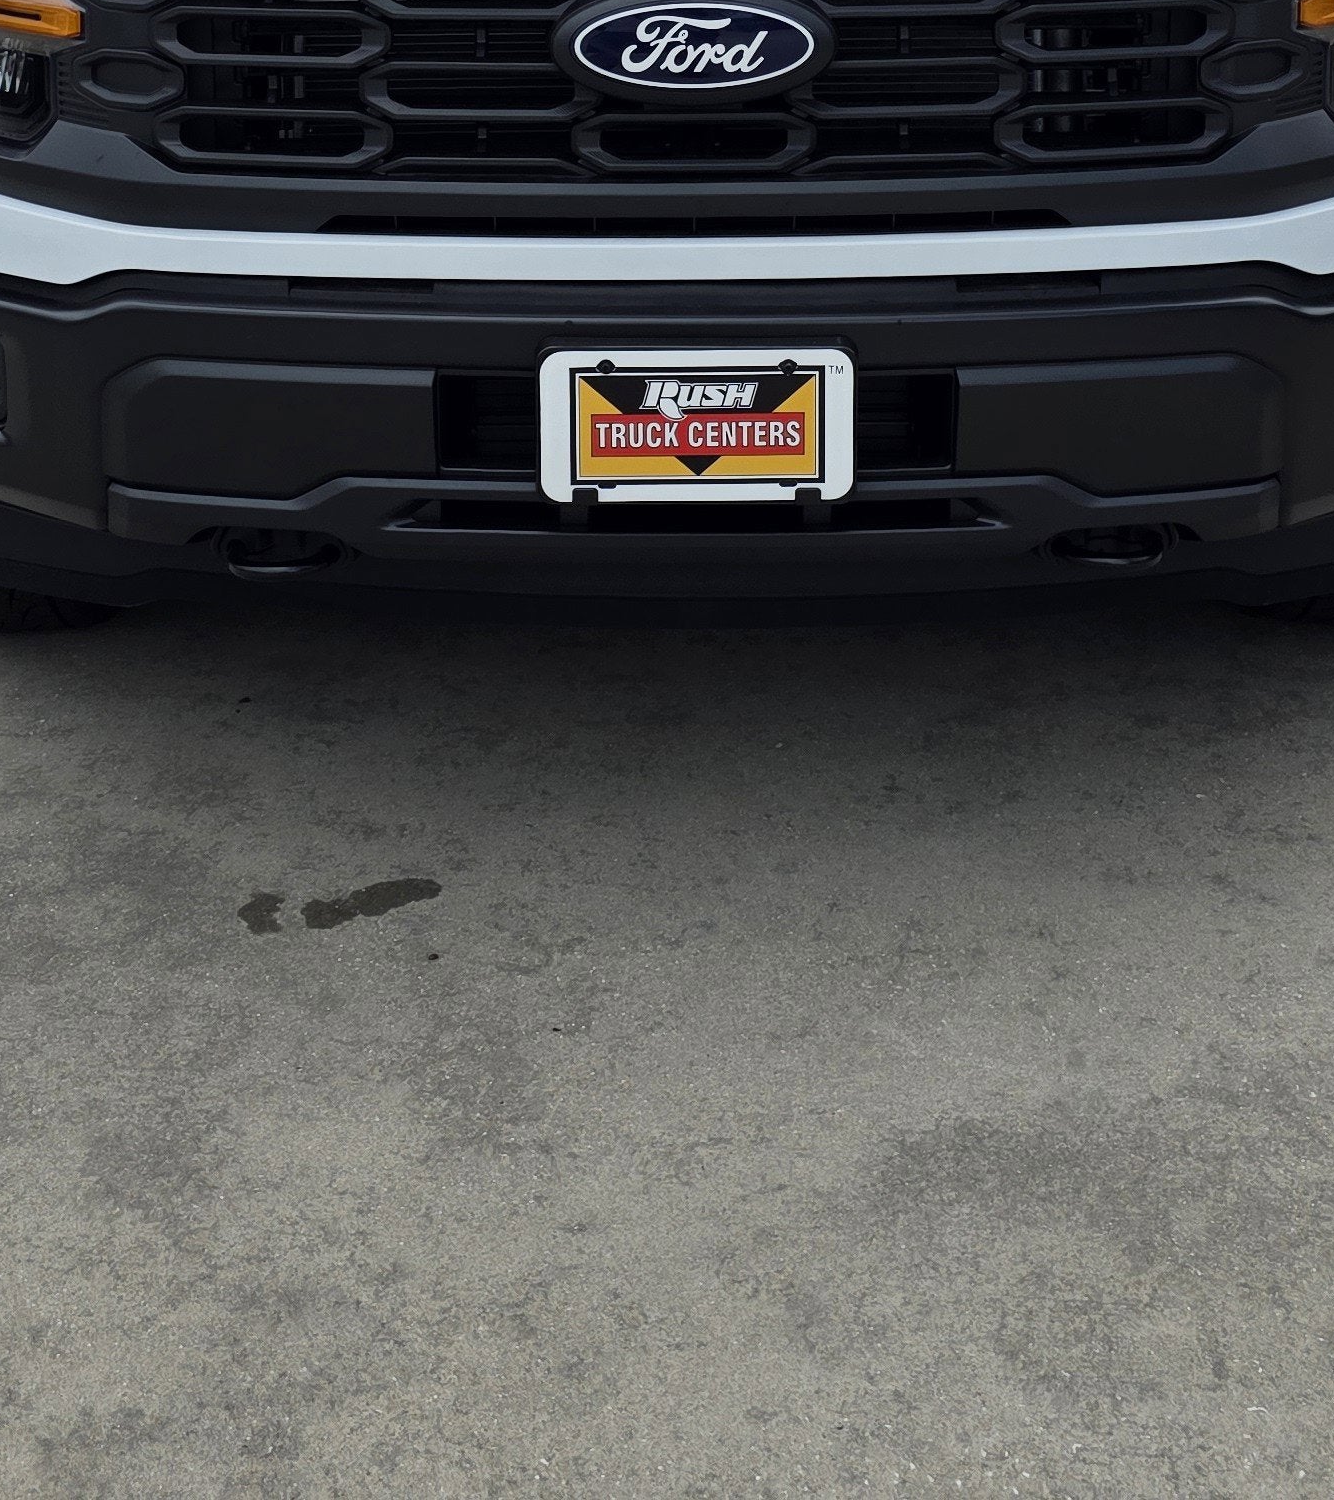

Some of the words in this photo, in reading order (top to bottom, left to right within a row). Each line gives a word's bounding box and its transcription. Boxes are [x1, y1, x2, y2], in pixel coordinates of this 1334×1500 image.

[621, 15, 769, 74] Ford
[639, 379, 759, 421] RUSH
[595, 421, 681, 449] TRUCK
[687, 420, 802, 447] CENTERS
